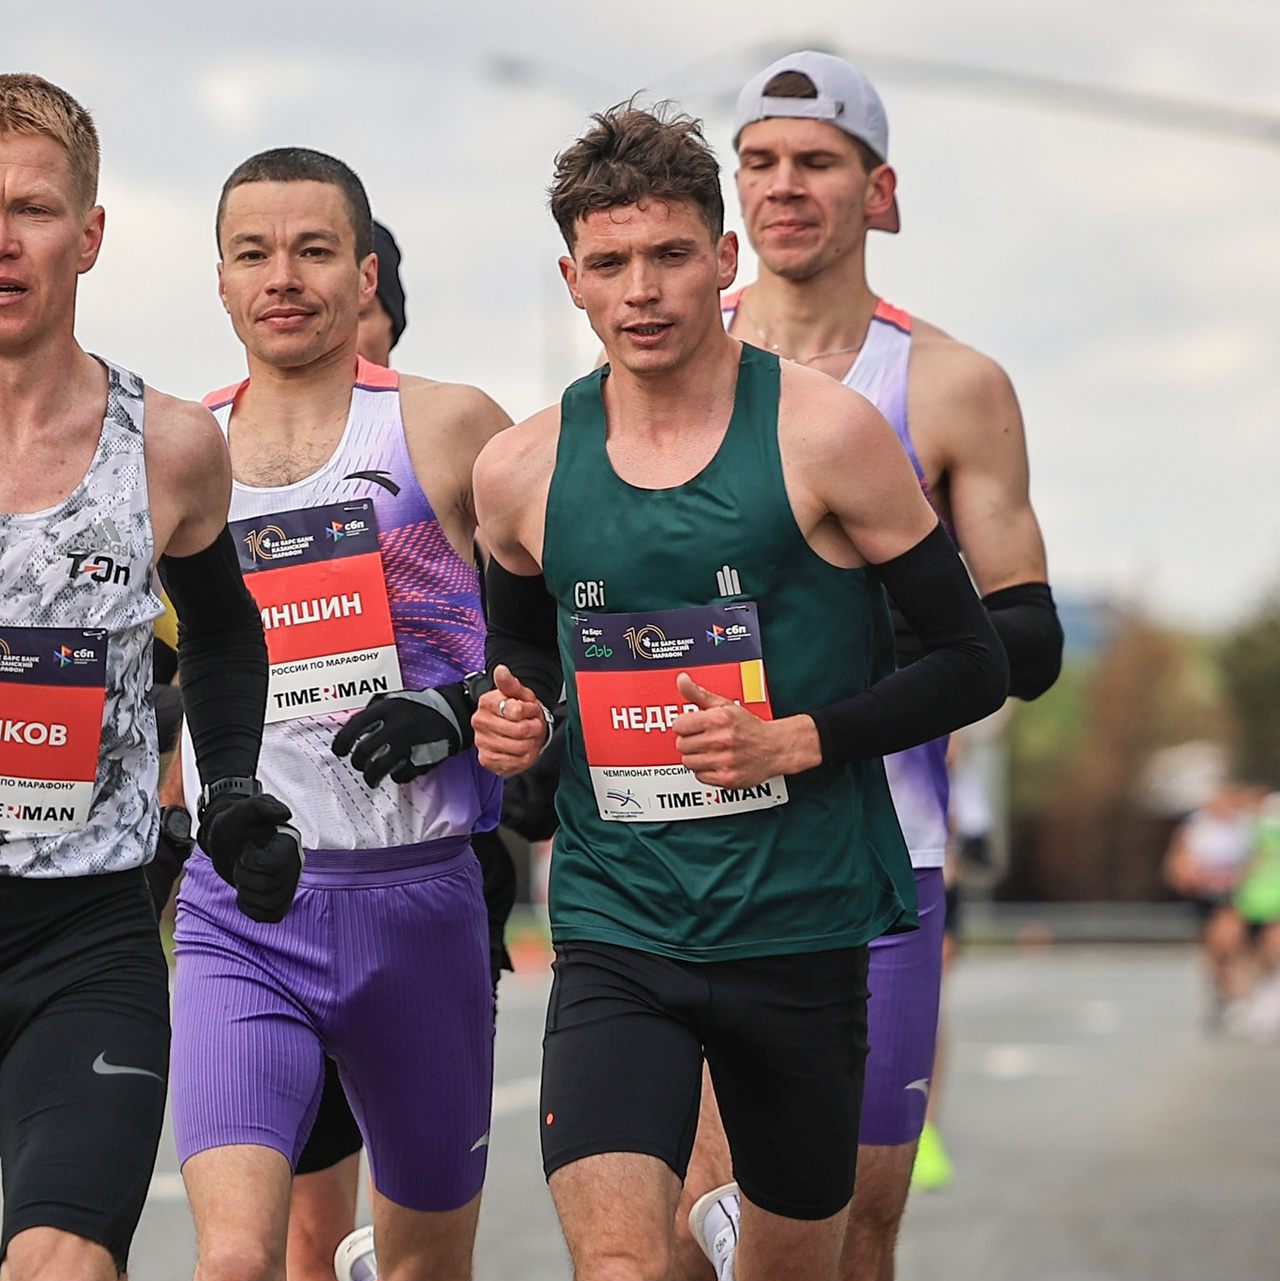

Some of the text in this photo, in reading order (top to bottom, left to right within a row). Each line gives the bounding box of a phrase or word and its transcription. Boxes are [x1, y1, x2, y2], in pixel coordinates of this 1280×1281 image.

[344, 520, 365, 531] сбп
[574, 581, 605, 608] GRi
[725, 625, 747, 635] сбп
[73, 648, 95, 659] сбп
[271, 651, 379, 676] РОССИИ ПО МАРАФОНУ
[602, 769, 652, 777] ЧЕМПИОНАТ
[0, 778, 16, 788] ПО
[17, 780, 76, 791] МАРАФОНУ
